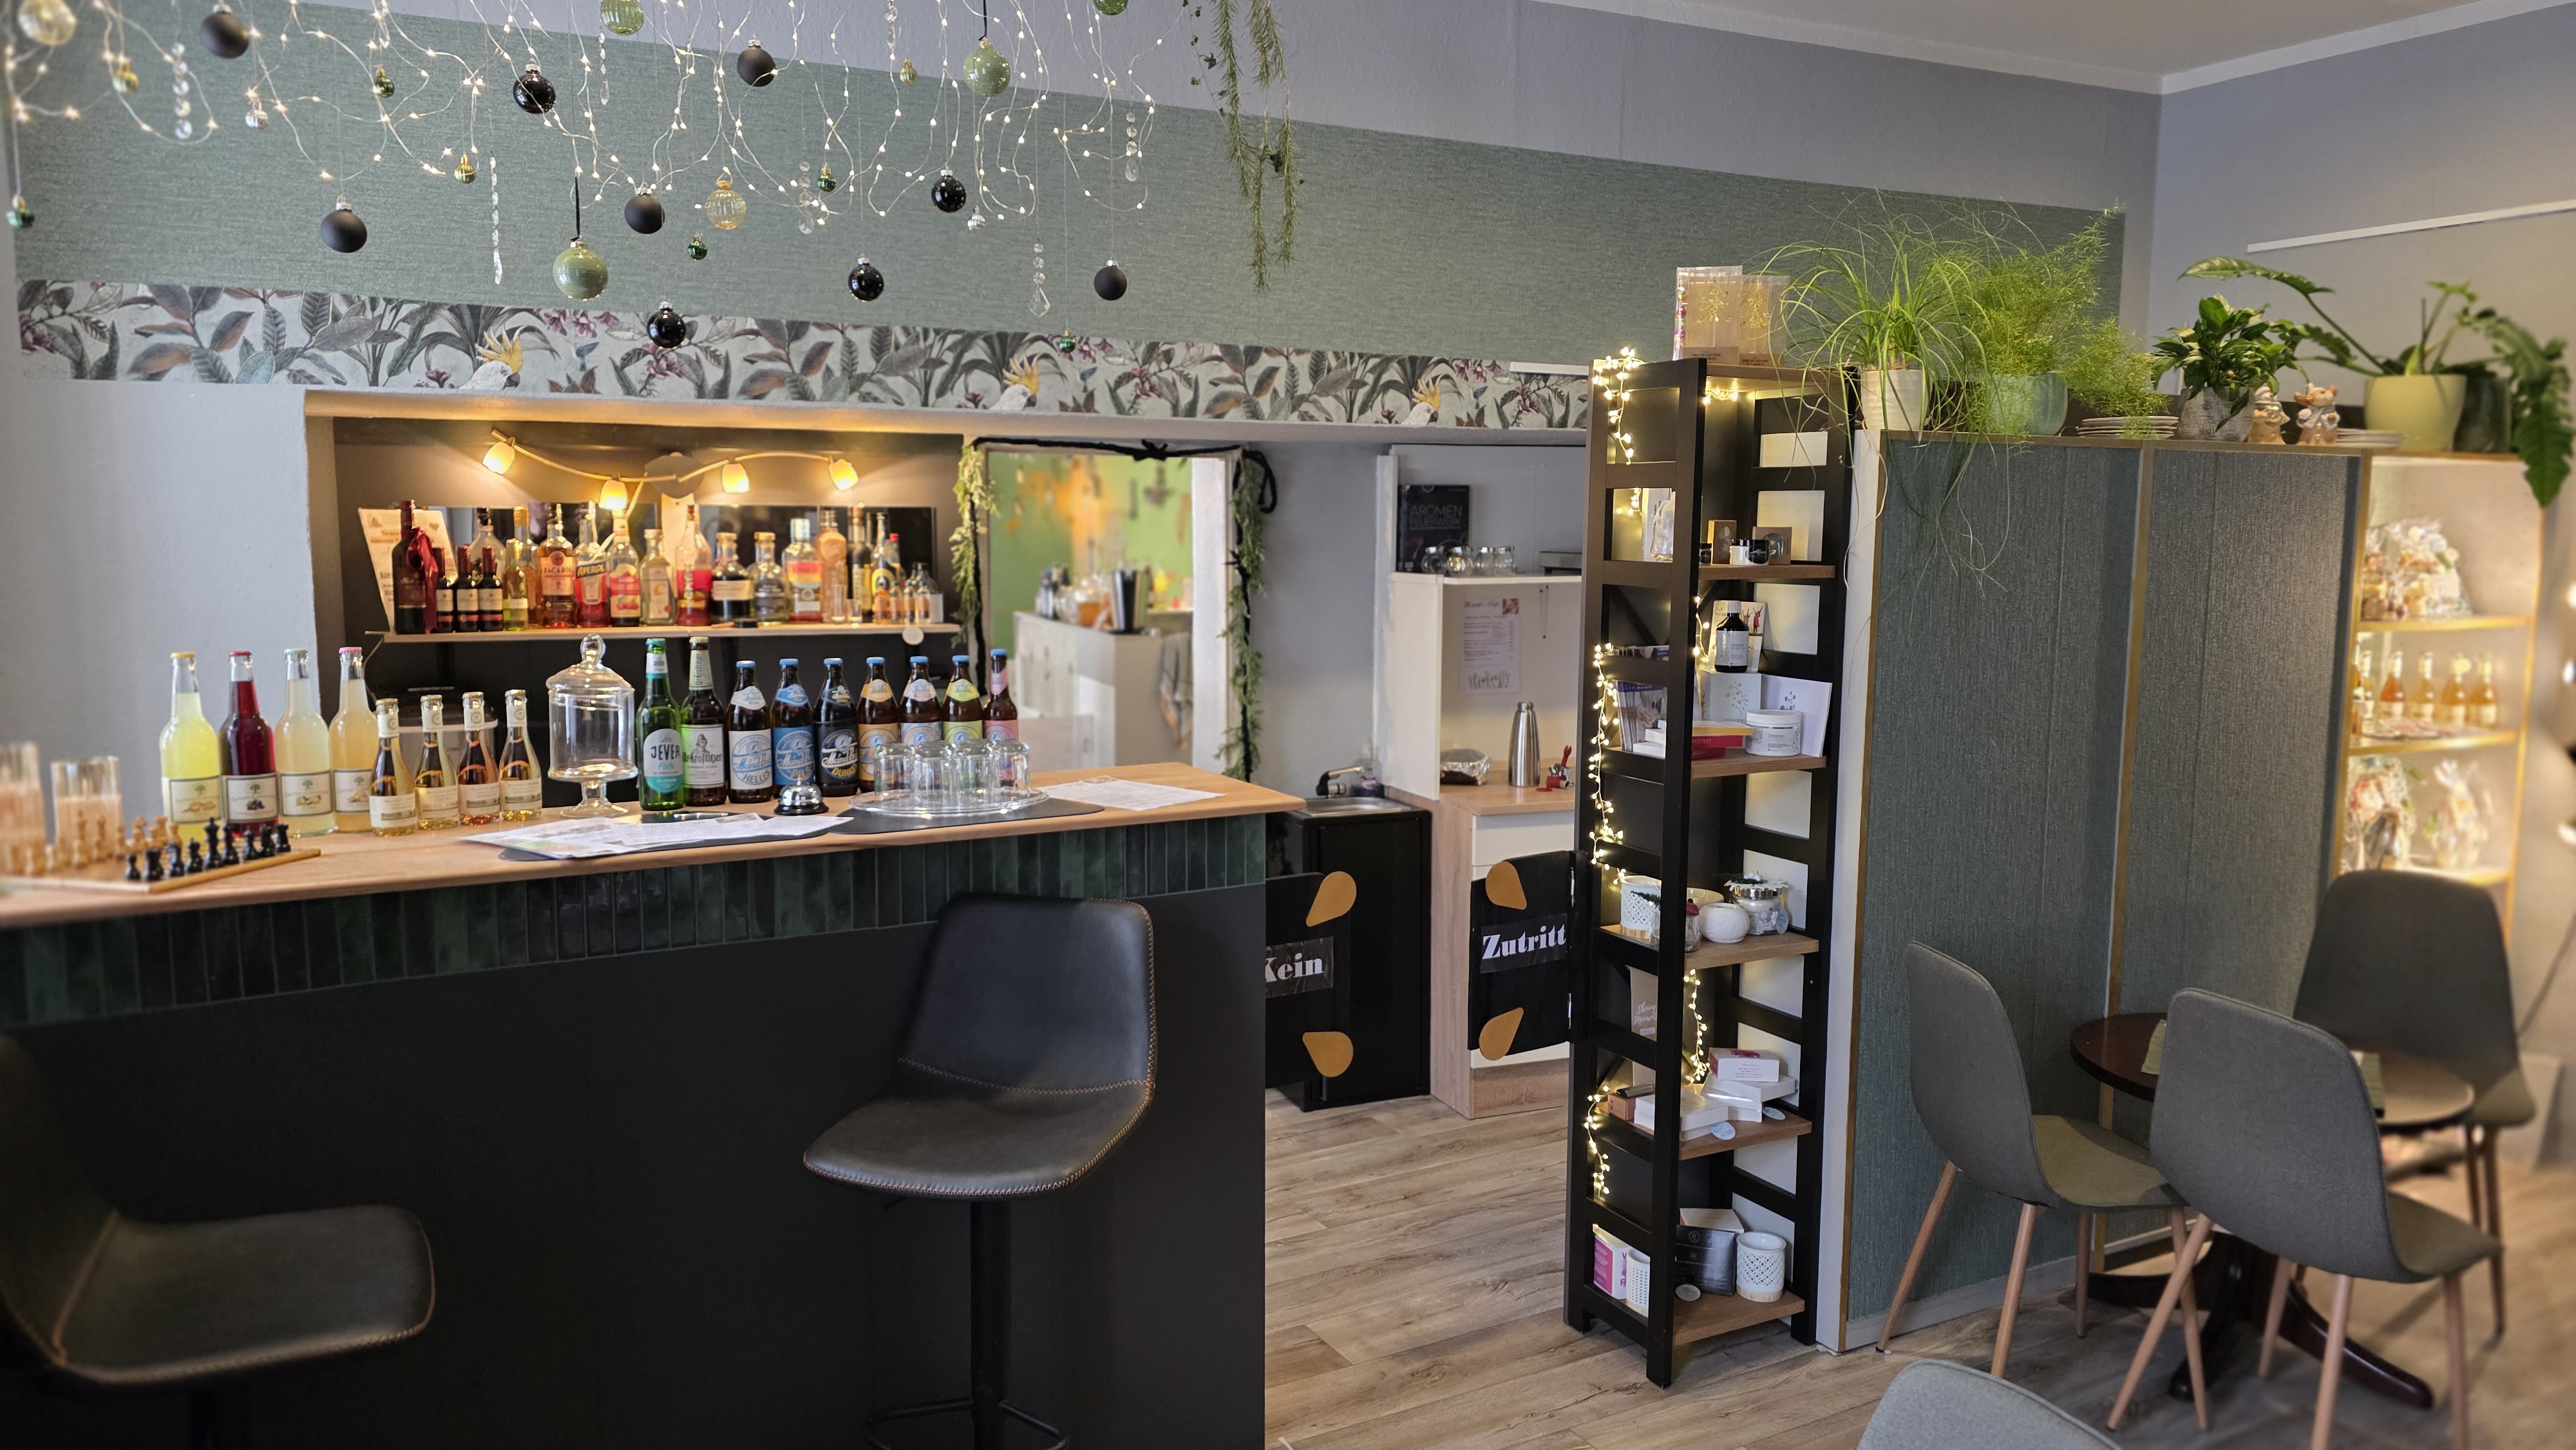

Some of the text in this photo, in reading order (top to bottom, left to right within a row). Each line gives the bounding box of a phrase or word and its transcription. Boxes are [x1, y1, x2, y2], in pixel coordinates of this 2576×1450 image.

[1410, 505, 1463, 516] AROMEN
[1410, 518, 1461, 526] FEUERWERK
[577, 564, 604, 576] APEROL
[650, 744, 680, 760] JEVER
[743, 769, 771, 784] HELLES
[790, 767, 813, 778] PILS
[831, 763, 858, 777] DUNKE
[1482, 923, 1567, 959] Zutritt
[1265, 952, 1324, 983] Kein
